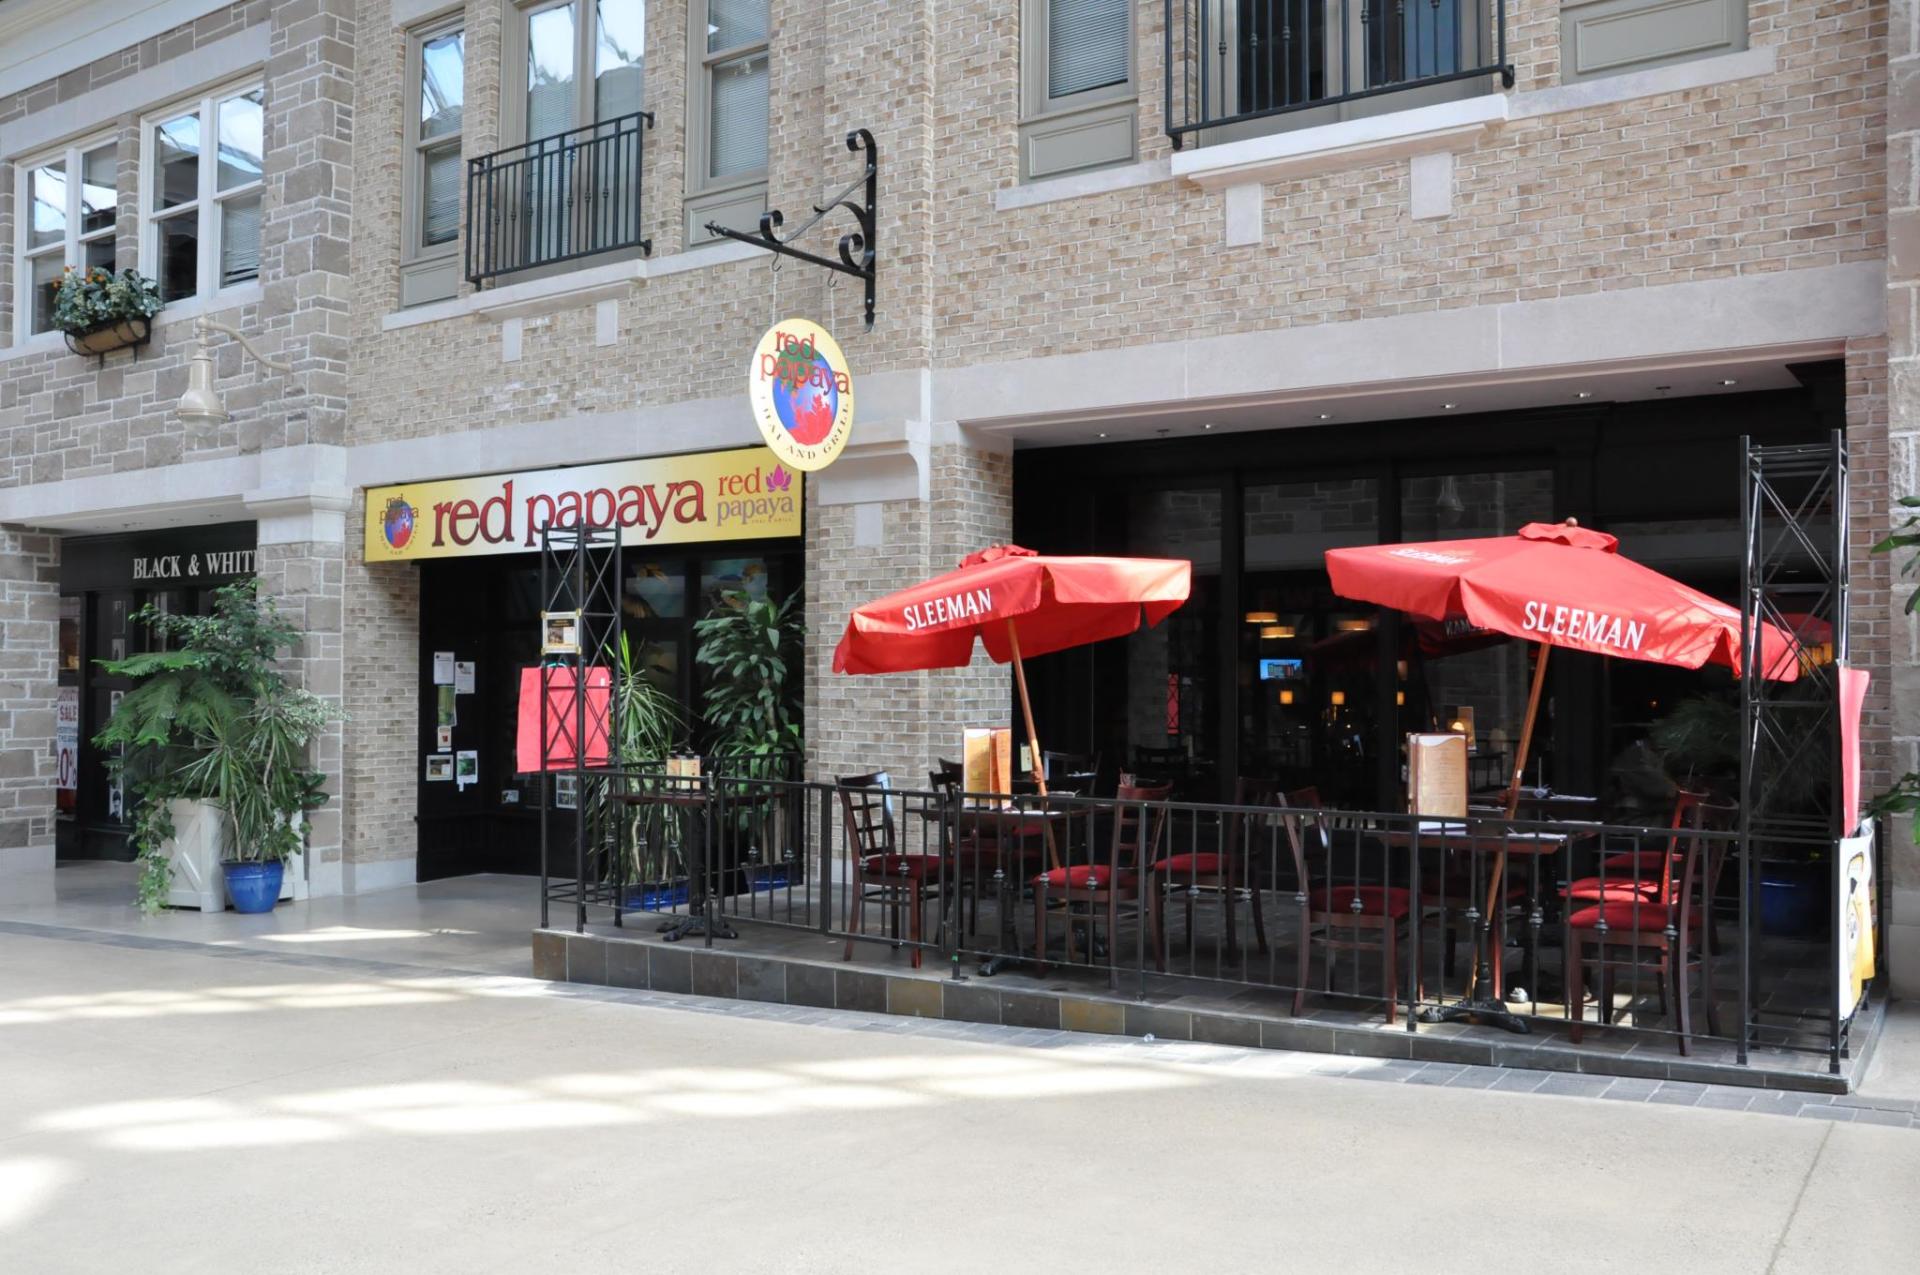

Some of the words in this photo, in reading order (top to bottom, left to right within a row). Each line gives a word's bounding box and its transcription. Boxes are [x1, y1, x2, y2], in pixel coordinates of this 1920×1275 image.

[775, 330, 816, 361] red
[760, 352, 851, 396] papaya
[786, 444, 816, 460] AND
[823, 404, 849, 454] GRILL
[718, 466, 762, 497] red
[431, 479, 515, 547] red
[524, 479, 707, 548] papaya
[717, 496, 795, 527] papaya
[132, 555, 182, 579] BLACK
[187, 554, 200, 576] &
[903, 587, 993, 632] SLEEMAN
[1522, 600, 1648, 652] SLEEMAN
